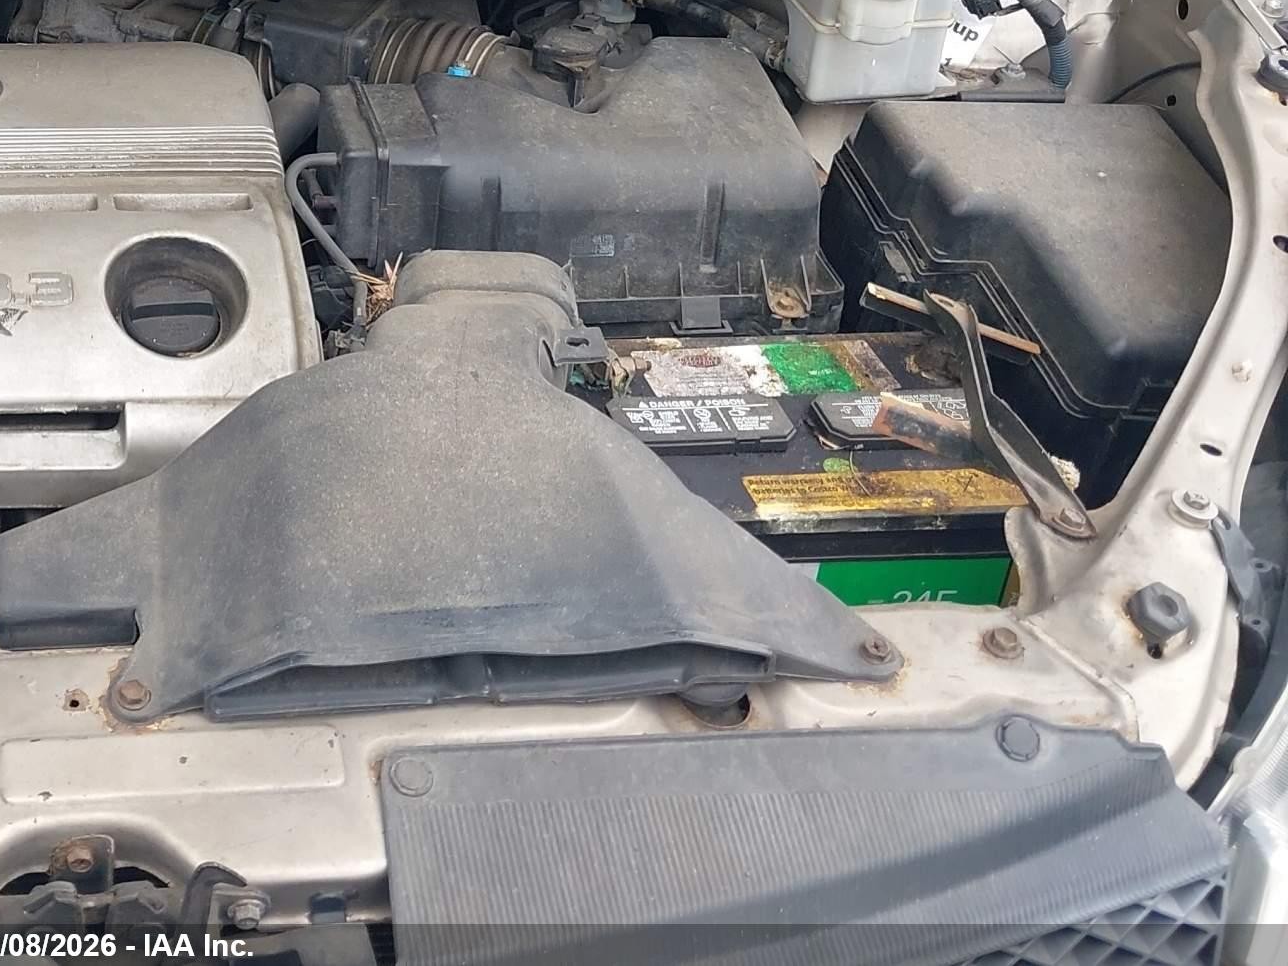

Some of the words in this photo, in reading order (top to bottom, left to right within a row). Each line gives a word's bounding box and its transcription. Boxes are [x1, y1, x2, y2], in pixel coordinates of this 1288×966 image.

[947, 21, 979, 42] up
[648, 400, 694, 408] DANGER
[703, 398, 746, 407] POISON
